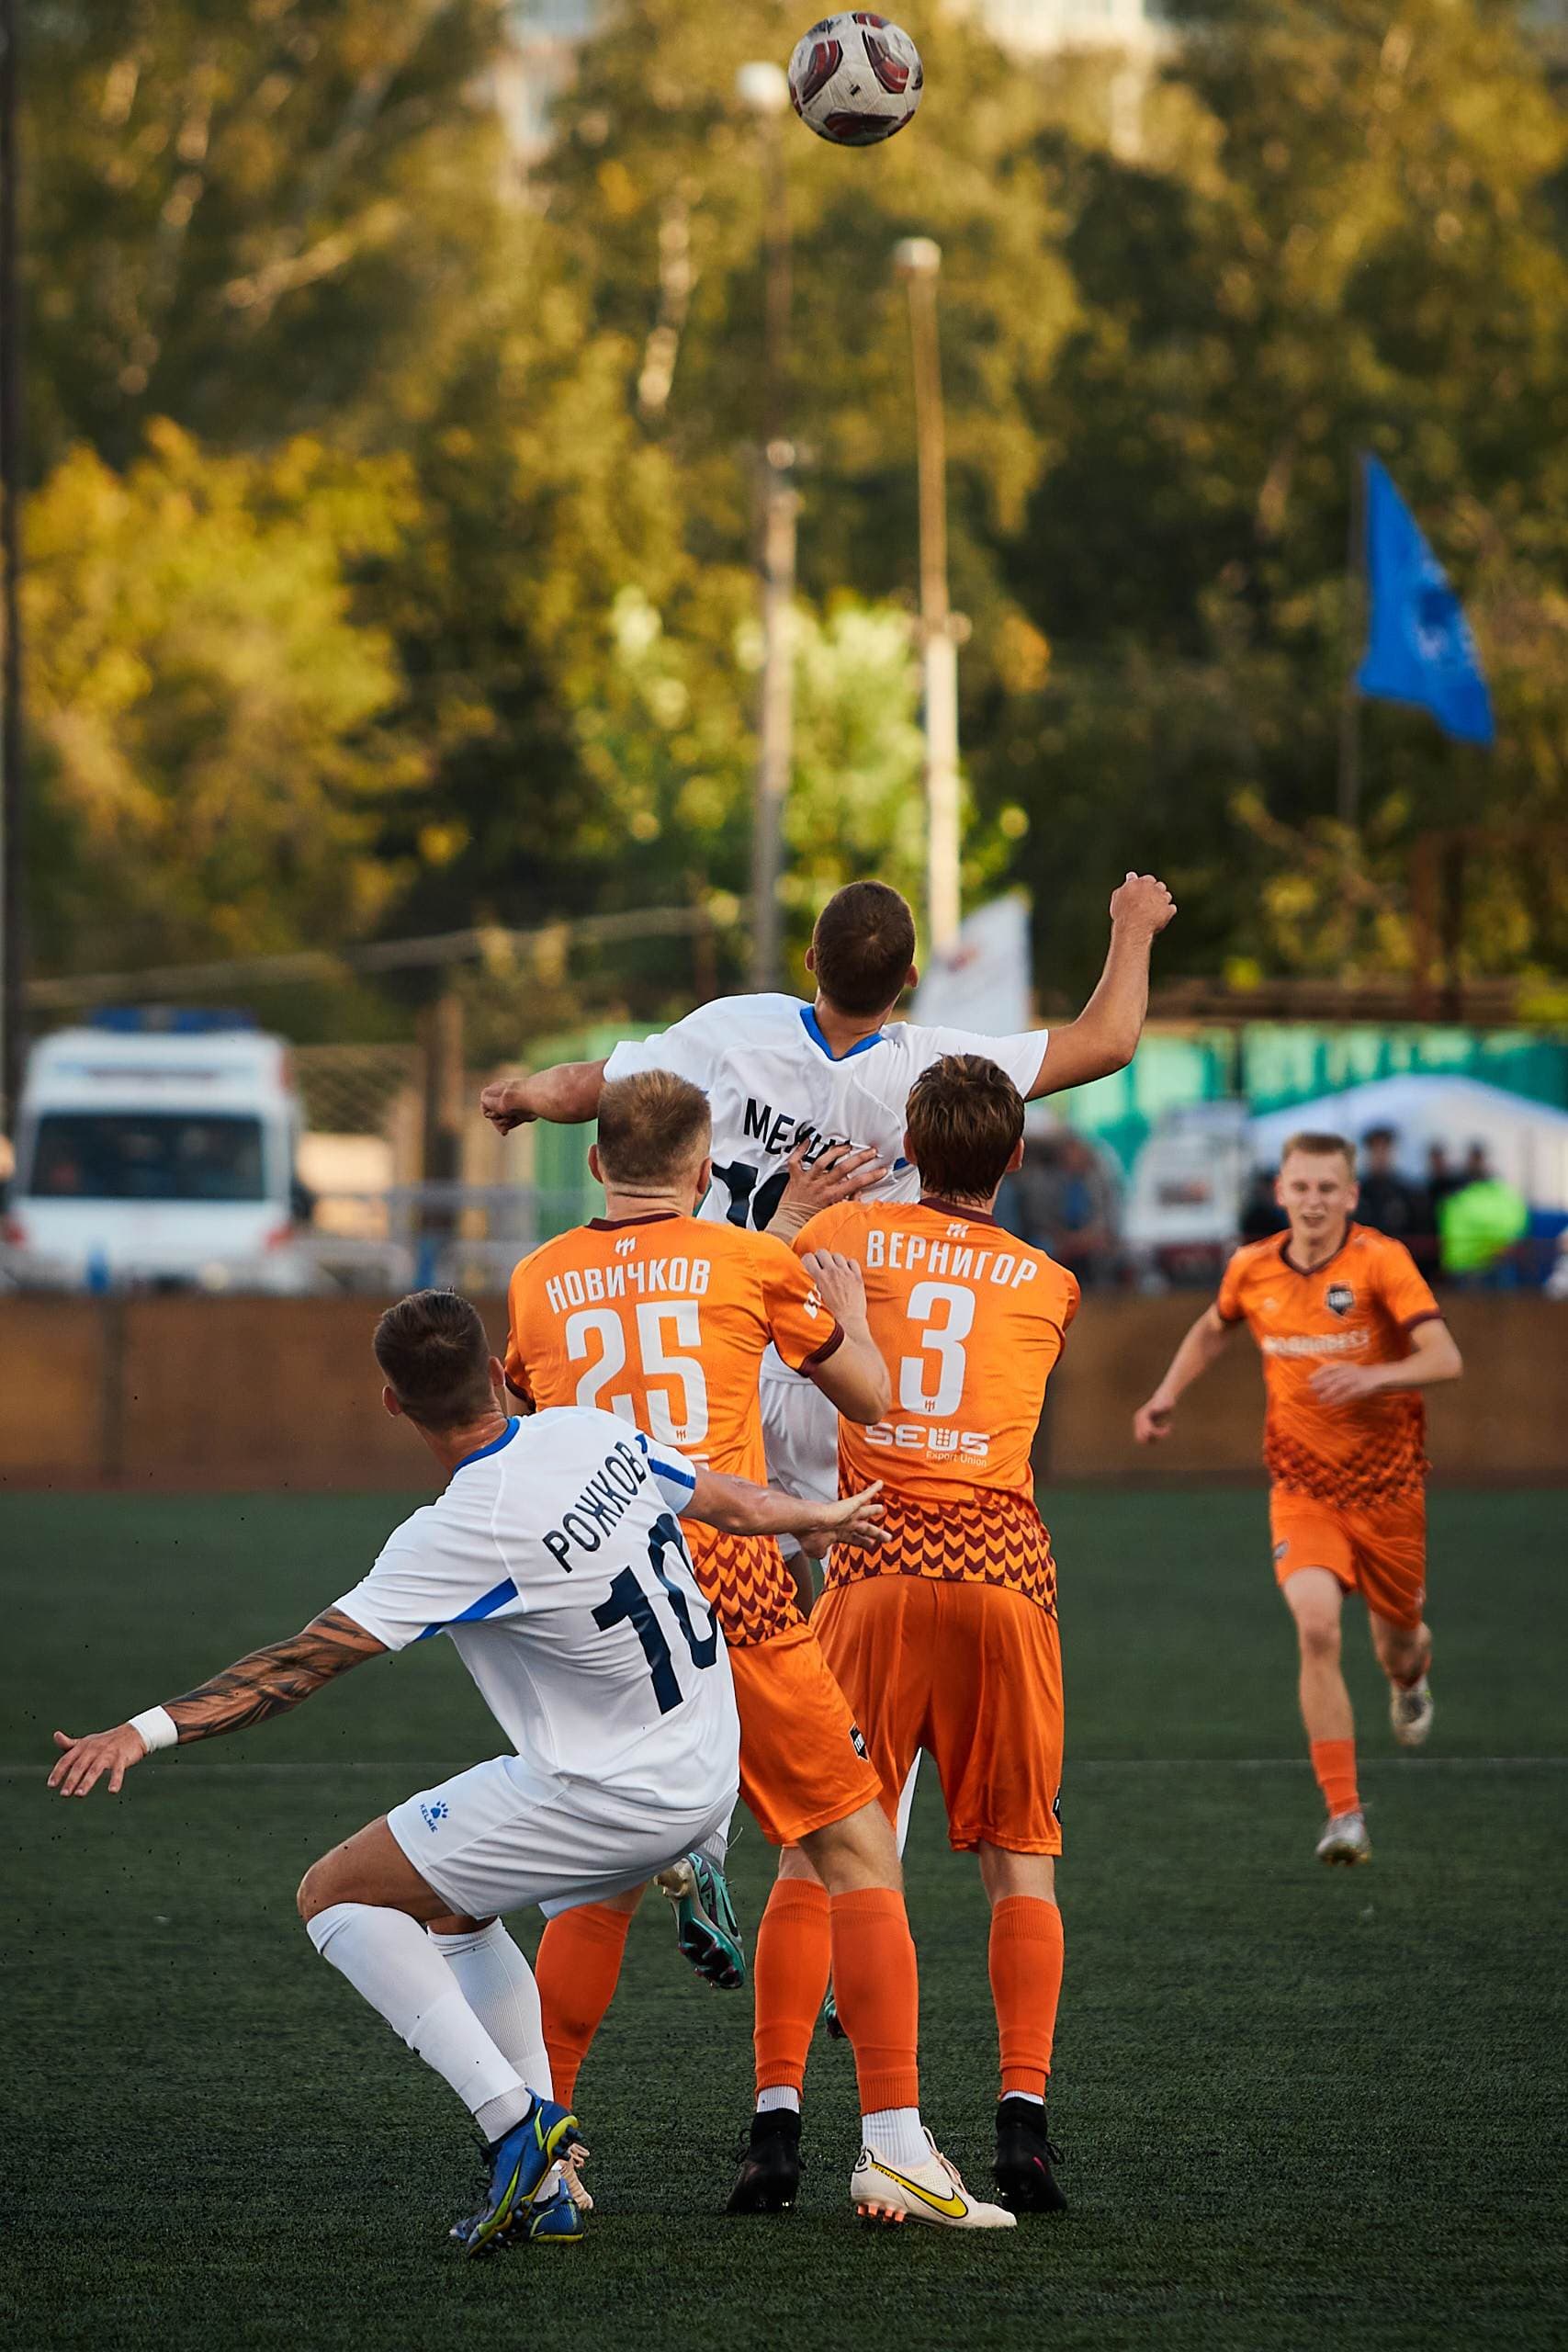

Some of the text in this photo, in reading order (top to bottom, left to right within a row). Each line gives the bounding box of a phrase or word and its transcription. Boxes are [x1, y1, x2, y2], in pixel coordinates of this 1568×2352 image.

[545, 1257, 712, 1315] НОВИЧКОВ
[866, 1229, 1038, 1290] ВЕРНИГОР
[565, 1299, 710, 1446] 25
[898, 1281, 976, 1418] 3
[864, 1421, 990, 1456] SEUS
[925, 1450, 987, 1468] Export Union
[542, 1440, 648, 1574] РОЖКОВ
[591, 1512, 717, 1715] 10
[419, 1802, 438, 1834] KELME
